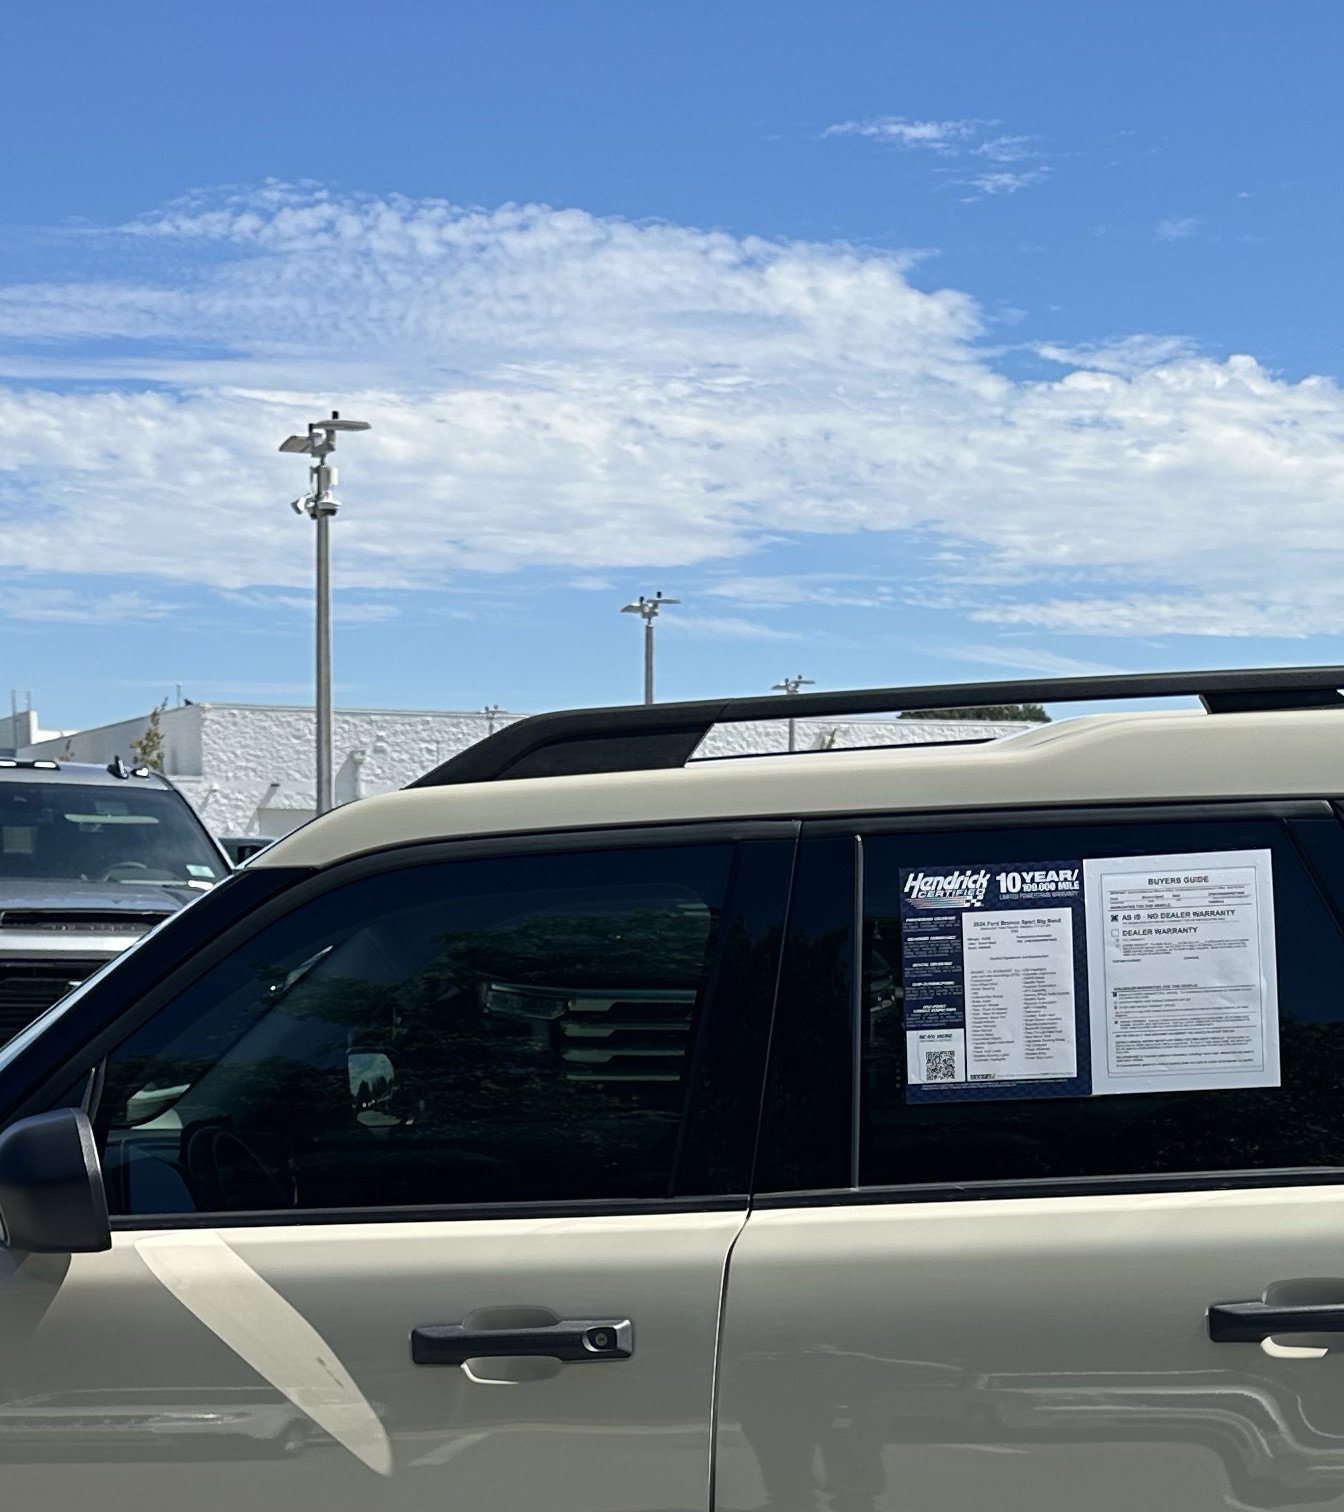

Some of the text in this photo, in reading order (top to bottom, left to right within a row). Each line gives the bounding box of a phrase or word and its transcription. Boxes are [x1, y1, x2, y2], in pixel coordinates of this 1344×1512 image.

[904, 870, 991, 898] Hendrick
[996, 869, 1079, 893] 10 YEAR/
[1148, 876, 1209, 886] BUYERS GUIDE
[918, 888, 986, 899] CERTIFIED
[1160, 911, 1191, 919] DEALER
[1192, 909, 1236, 918] WARRANTY
[1122, 926, 1198, 937] DEALER WARRANTY
